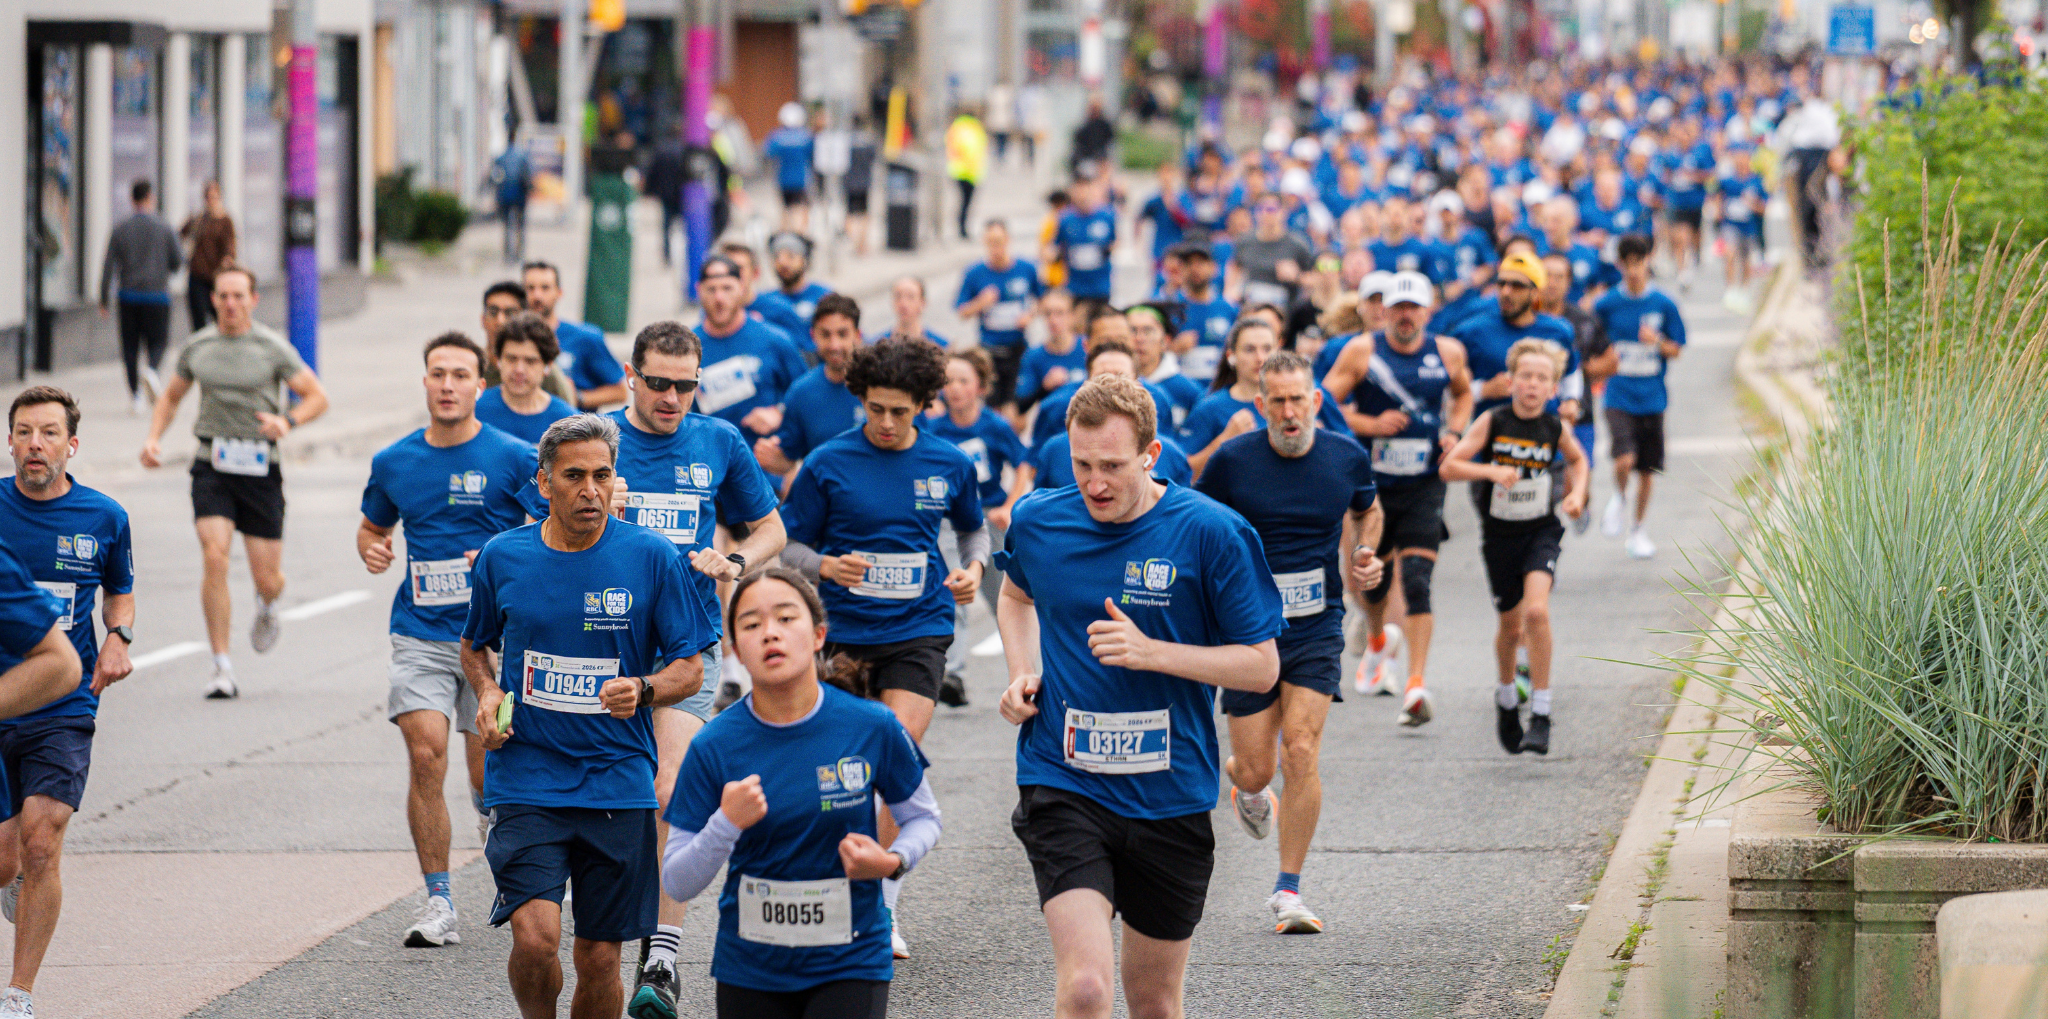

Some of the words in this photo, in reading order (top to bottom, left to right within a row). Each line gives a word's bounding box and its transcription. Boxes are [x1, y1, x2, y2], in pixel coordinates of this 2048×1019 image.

[637, 508, 679, 528] 06511
[868, 567, 913, 584] 09389
[607, 592, 626, 602] RACE
[1130, 596, 1170, 607] Sunnybrook
[1279, 586, 1312, 604] 7025
[606, 606, 626, 614] KIDS
[593, 623, 629, 631] Sunnybrook
[544, 671, 596, 697] 01943
[1089, 731, 1145, 754] 03127
[762, 901, 824, 925] 08055
